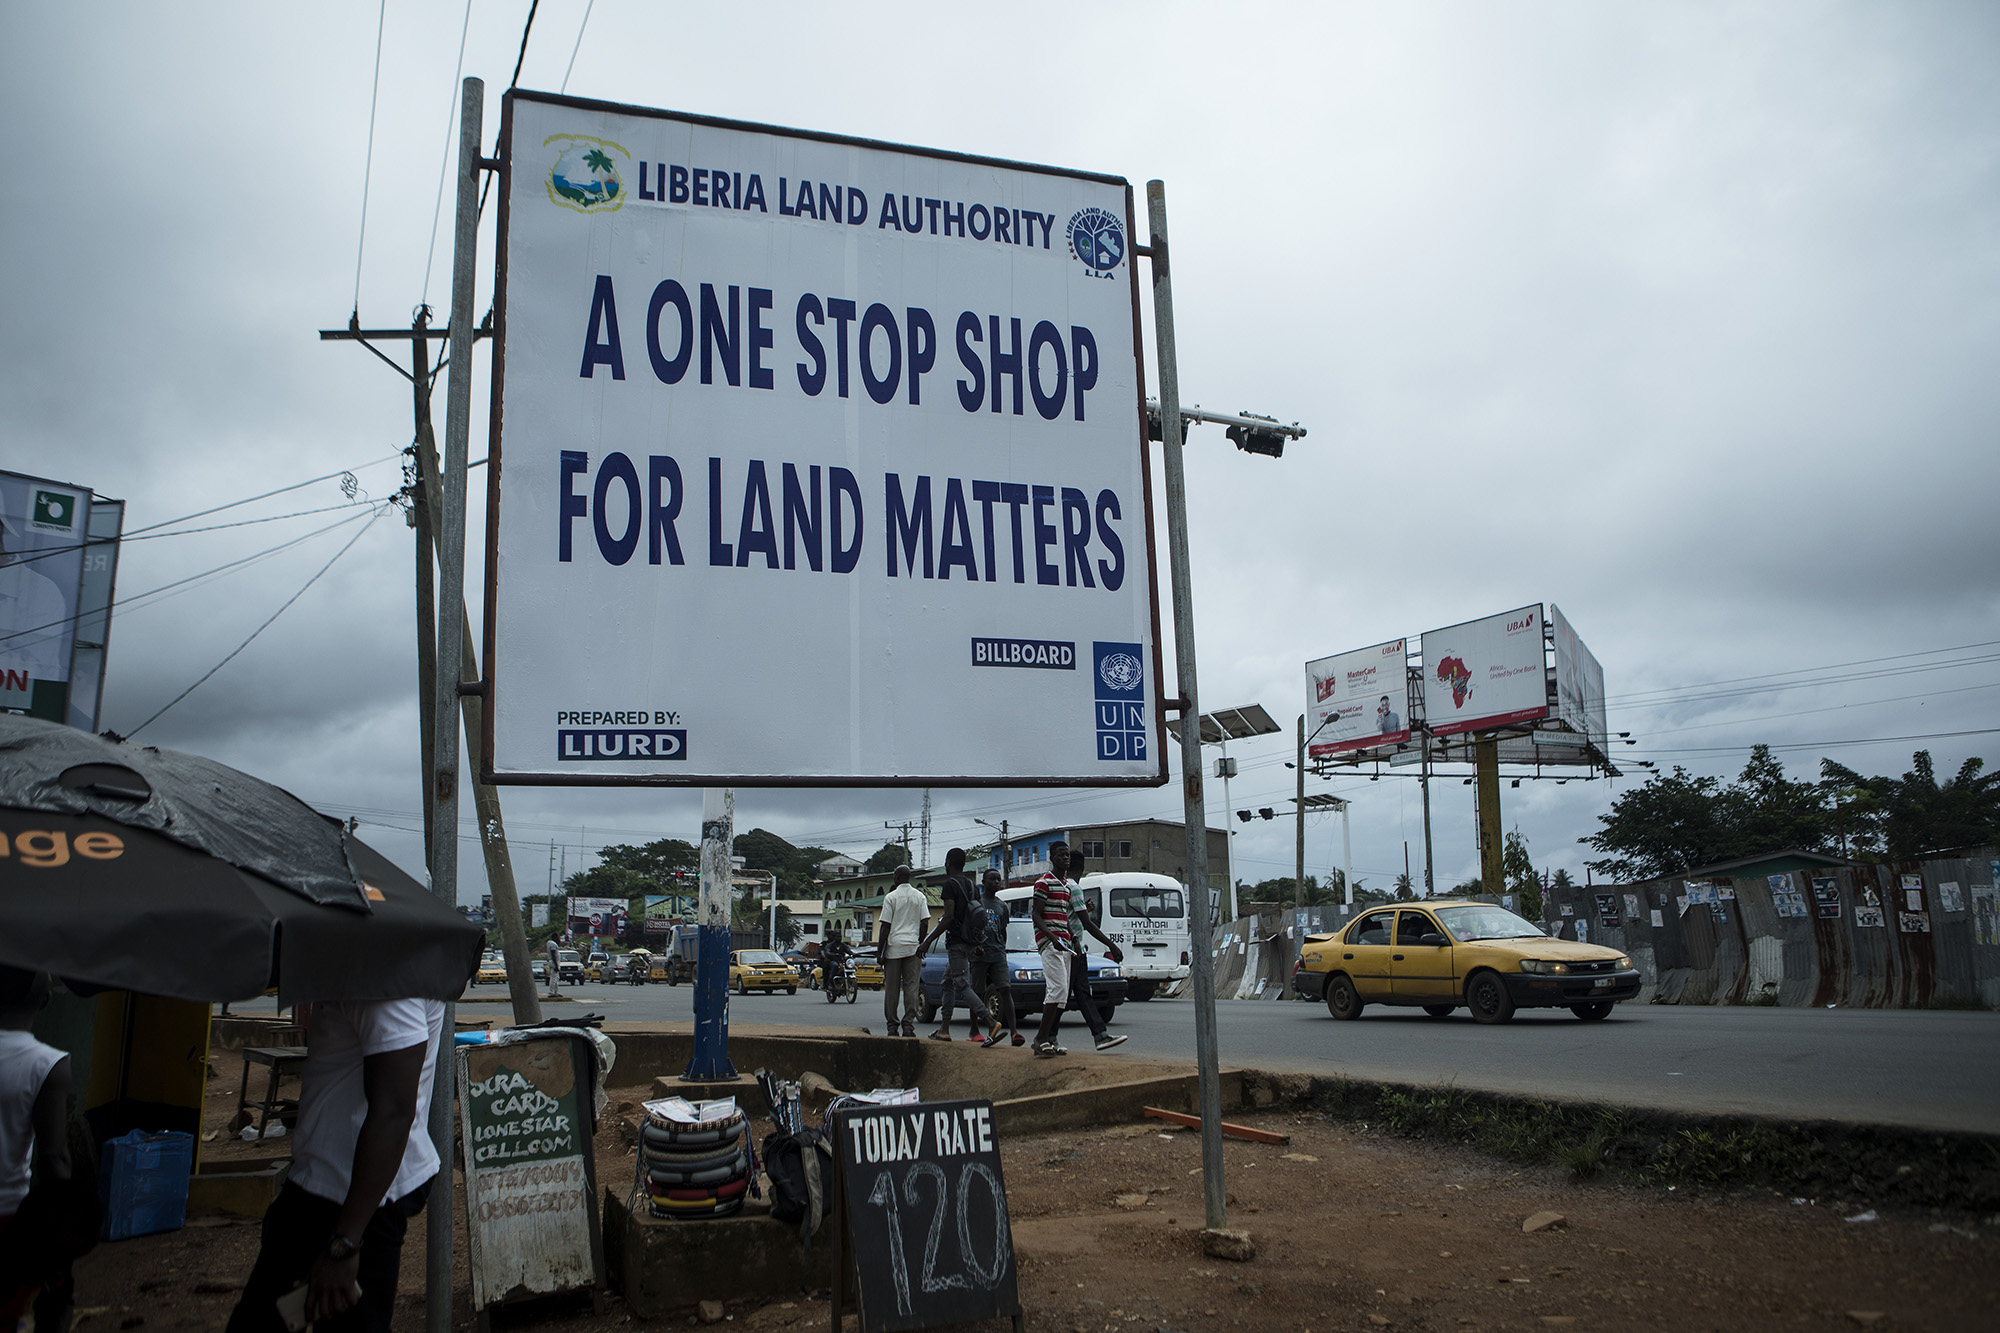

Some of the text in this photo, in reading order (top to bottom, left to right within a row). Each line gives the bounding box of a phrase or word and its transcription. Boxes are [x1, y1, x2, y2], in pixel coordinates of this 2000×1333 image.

[638, 160, 1056, 250] LIBERIA LAND AUTHORITY
[1065, 211, 1082, 239] LIBERIA
[1081, 207, 1101, 216] LAND
[1085, 269, 1115, 280] LLA
[579, 274, 1099, 422] A ONE STOP SHOP
[558, 449, 1125, 592] FOR LAND MATTERS
[1507, 620, 1524, 632] UBA
[976, 642, 1073, 665] BILLBOARD
[1382, 646, 1396, 655] UBA
[1347, 666, 1376, 679] MasterCard
[558, 711, 680, 725] PREPARED BY:
[564, 734, 681, 756] LIURD
[1546, 733, 1567, 741] MEDIA
[1131, 920, 1169, 929] HYUNDAI
[1109, 933, 1124, 943] BUS
[491, 1090, 560, 1116] CARDS
[848, 1106, 993, 1164] TODAY RATE
[475, 1134, 572, 1162] CELLCOM
[867, 1161, 1008, 1316] 120
